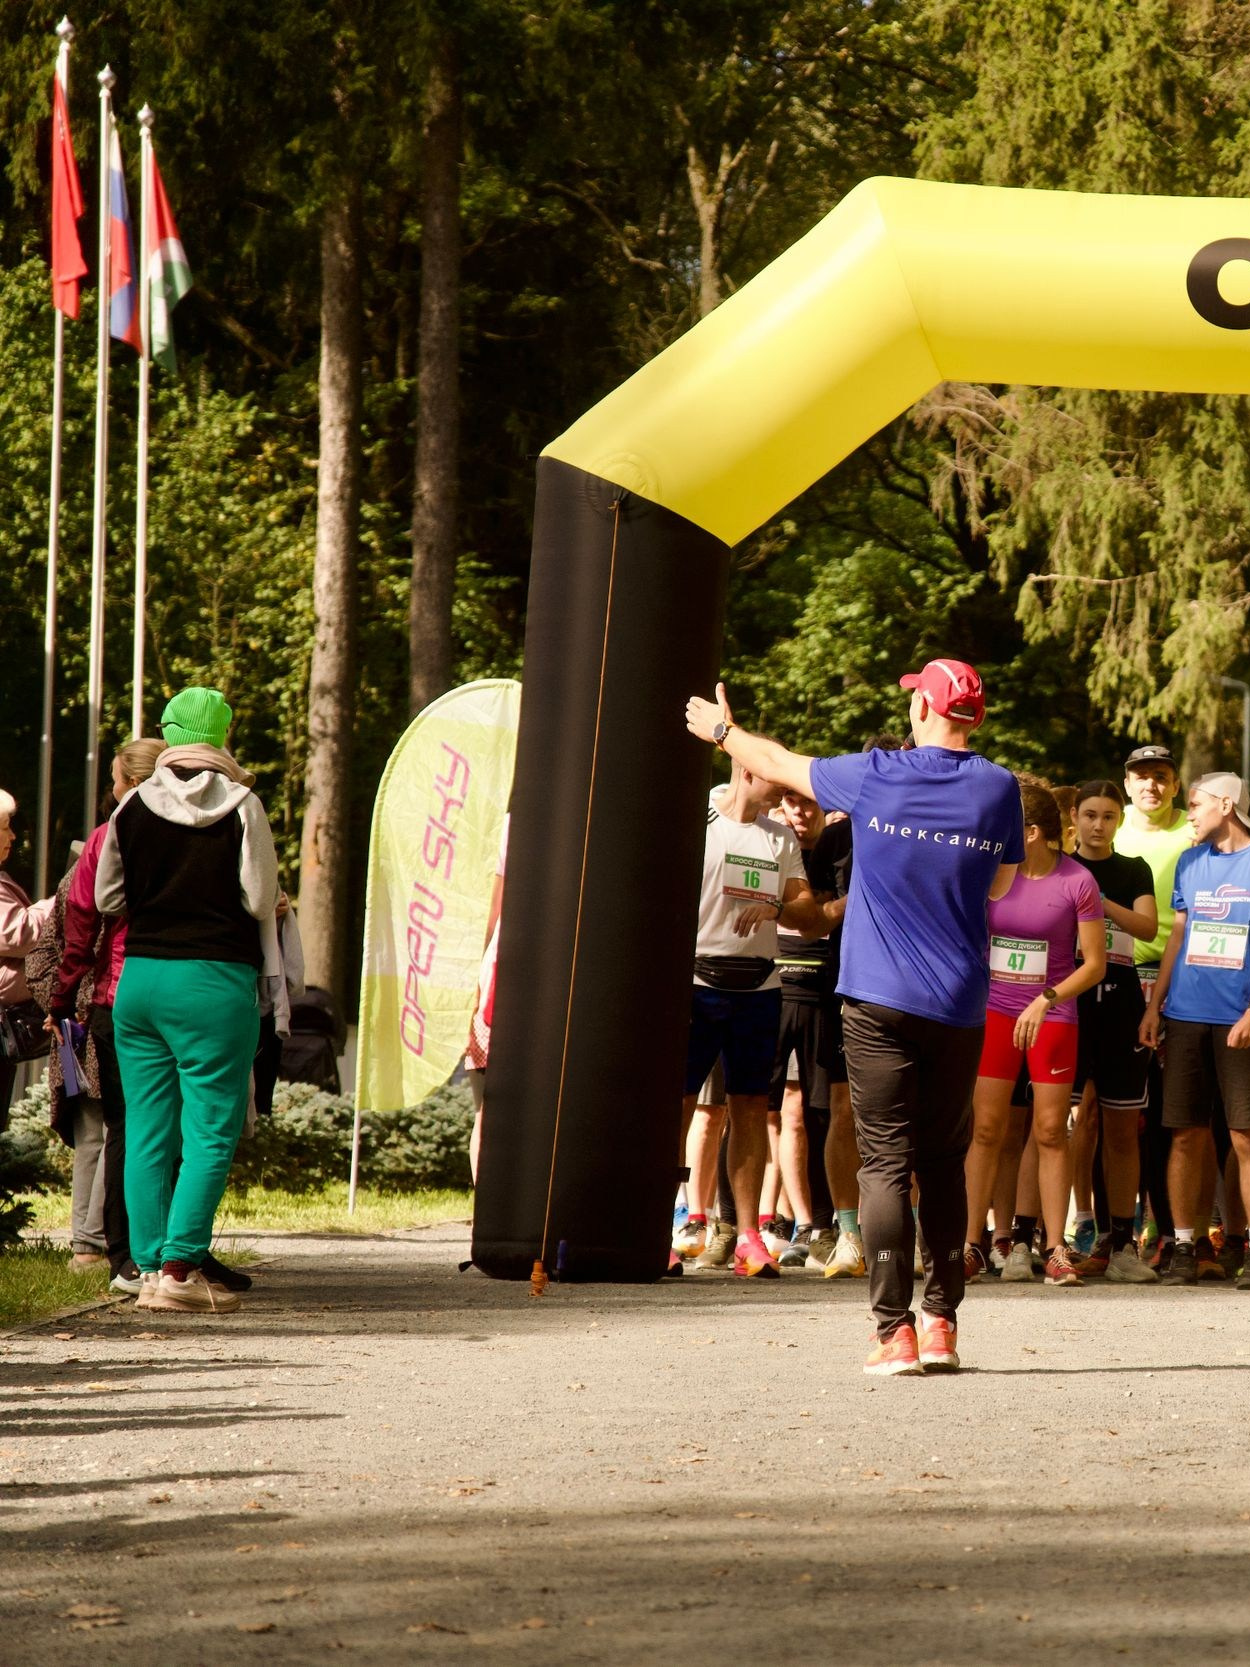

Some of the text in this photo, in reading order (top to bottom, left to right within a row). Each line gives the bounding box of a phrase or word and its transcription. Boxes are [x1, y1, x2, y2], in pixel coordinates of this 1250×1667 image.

[867, 816, 1003, 855] Александр
[730, 857, 775, 870] КРОСС ДУБКИ
[742, 869, 760, 889] 16
[400, 741, 472, 1057] OPEN SKY
[1197, 925, 1243, 935] КРОСС ДУБКИ
[996, 939, 1042, 950] КРОСС ДУБКИ
[1207, 936, 1227, 954] 21
[1007, 952, 1026, 972] 47
